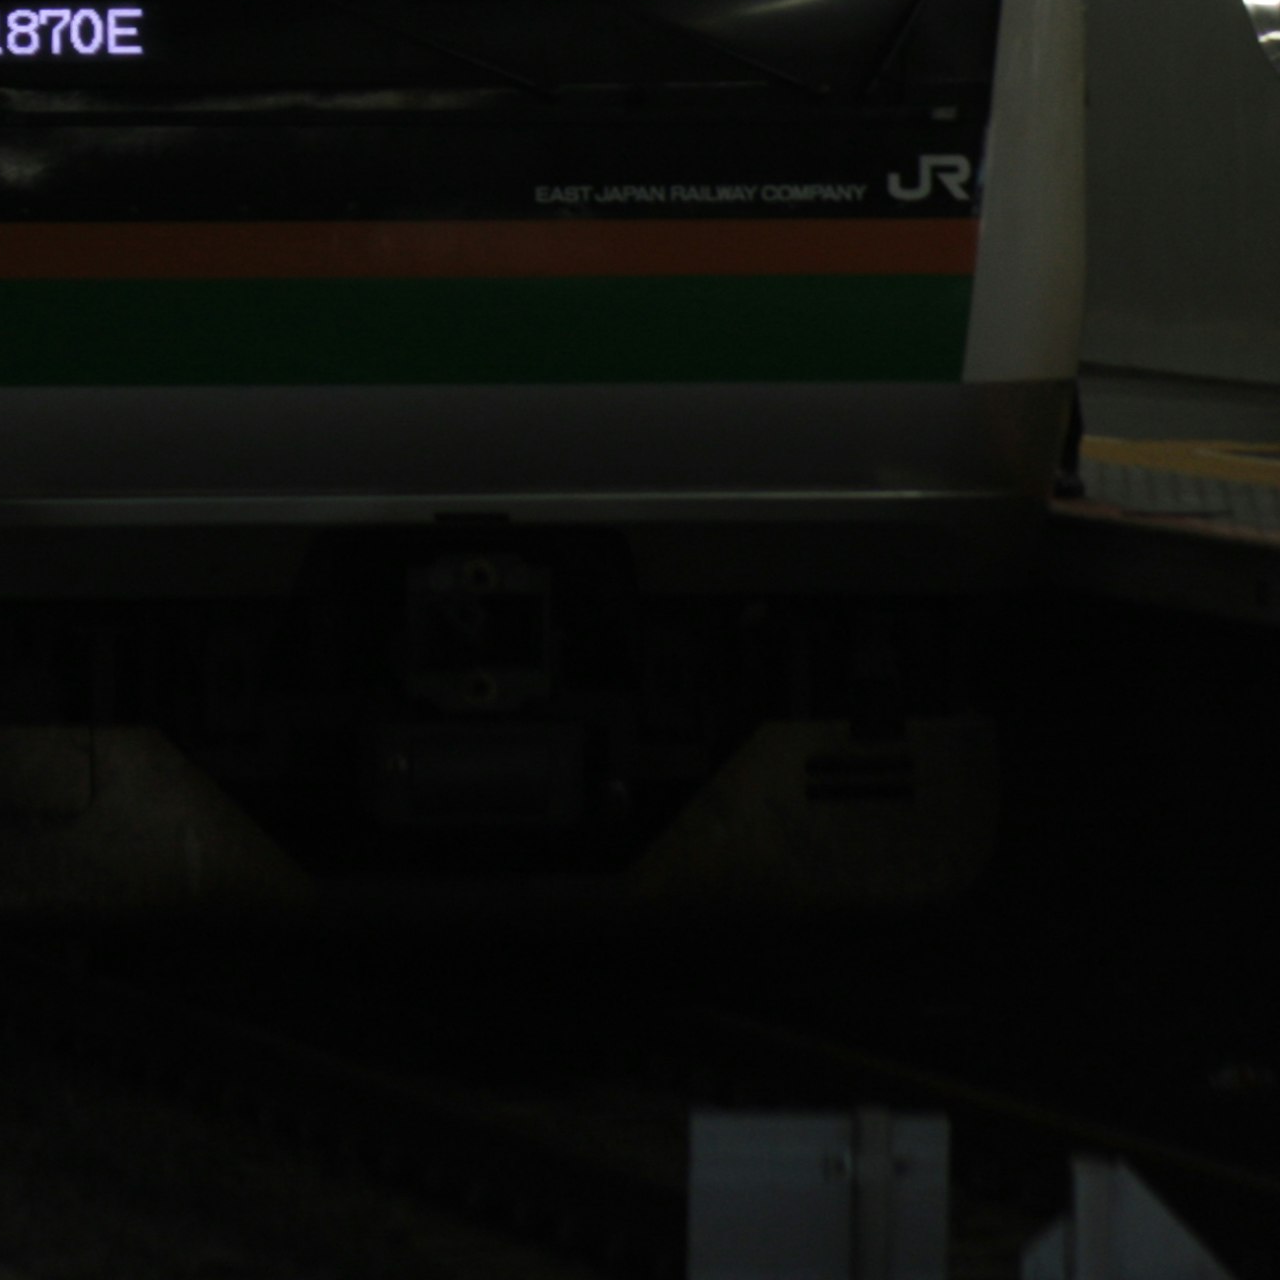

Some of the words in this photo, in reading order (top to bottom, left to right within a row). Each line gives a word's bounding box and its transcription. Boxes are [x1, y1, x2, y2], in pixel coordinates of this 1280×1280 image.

[534, 184, 593, 204] EAST
[594, 184, 667, 203] JAPAN
[671, 184, 757, 202] RAILWAY
[760, 183, 868, 202] COMPANY
[886, 153, 972, 202] JR
